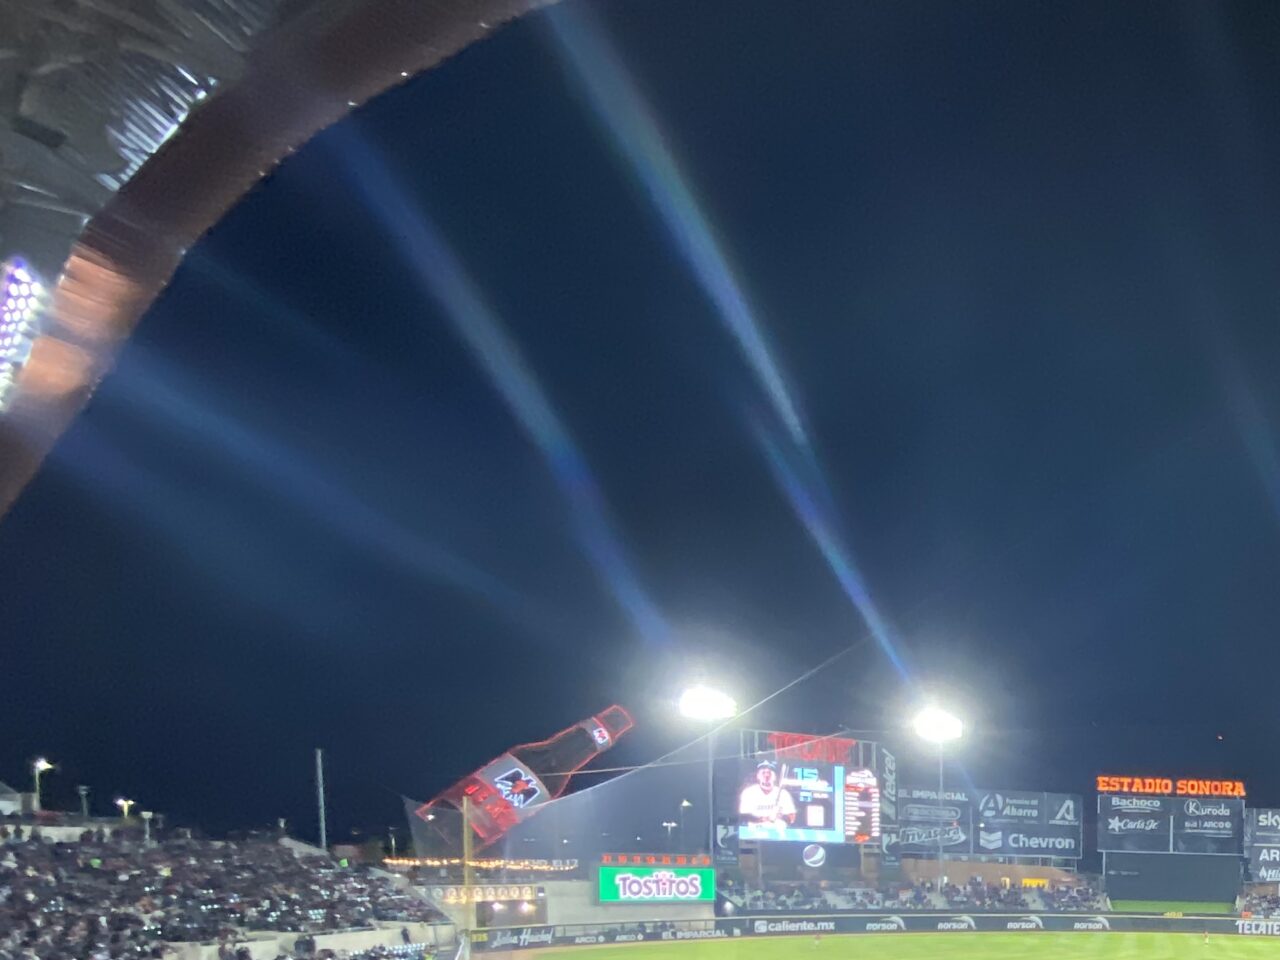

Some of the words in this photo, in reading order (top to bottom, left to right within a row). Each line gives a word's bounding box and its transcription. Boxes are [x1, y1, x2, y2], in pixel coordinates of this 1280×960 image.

[1096, 776, 1173, 794] ESTADIO
[1176, 778, 1247, 797] SONORA
[1111, 797, 1161, 808] Bachoco
[1188, 801, 1231, 815] Kuroda
[1003, 805, 1038, 817] Ahorro
[1203, 821, 1225, 829] ARCO
[1008, 833, 1075, 849] Chevron
[768, 920, 835, 932] caliente.mx
[866, 921, 898, 931] norson
[938, 920, 969, 930] norson
[1007, 920, 1036, 930] norson
[1074, 920, 1102, 930] norson
[1235, 919, 1280, 936] TECATE
[662, 931, 674, 940] EL
[676, 929, 728, 939] IMPARCIAL
